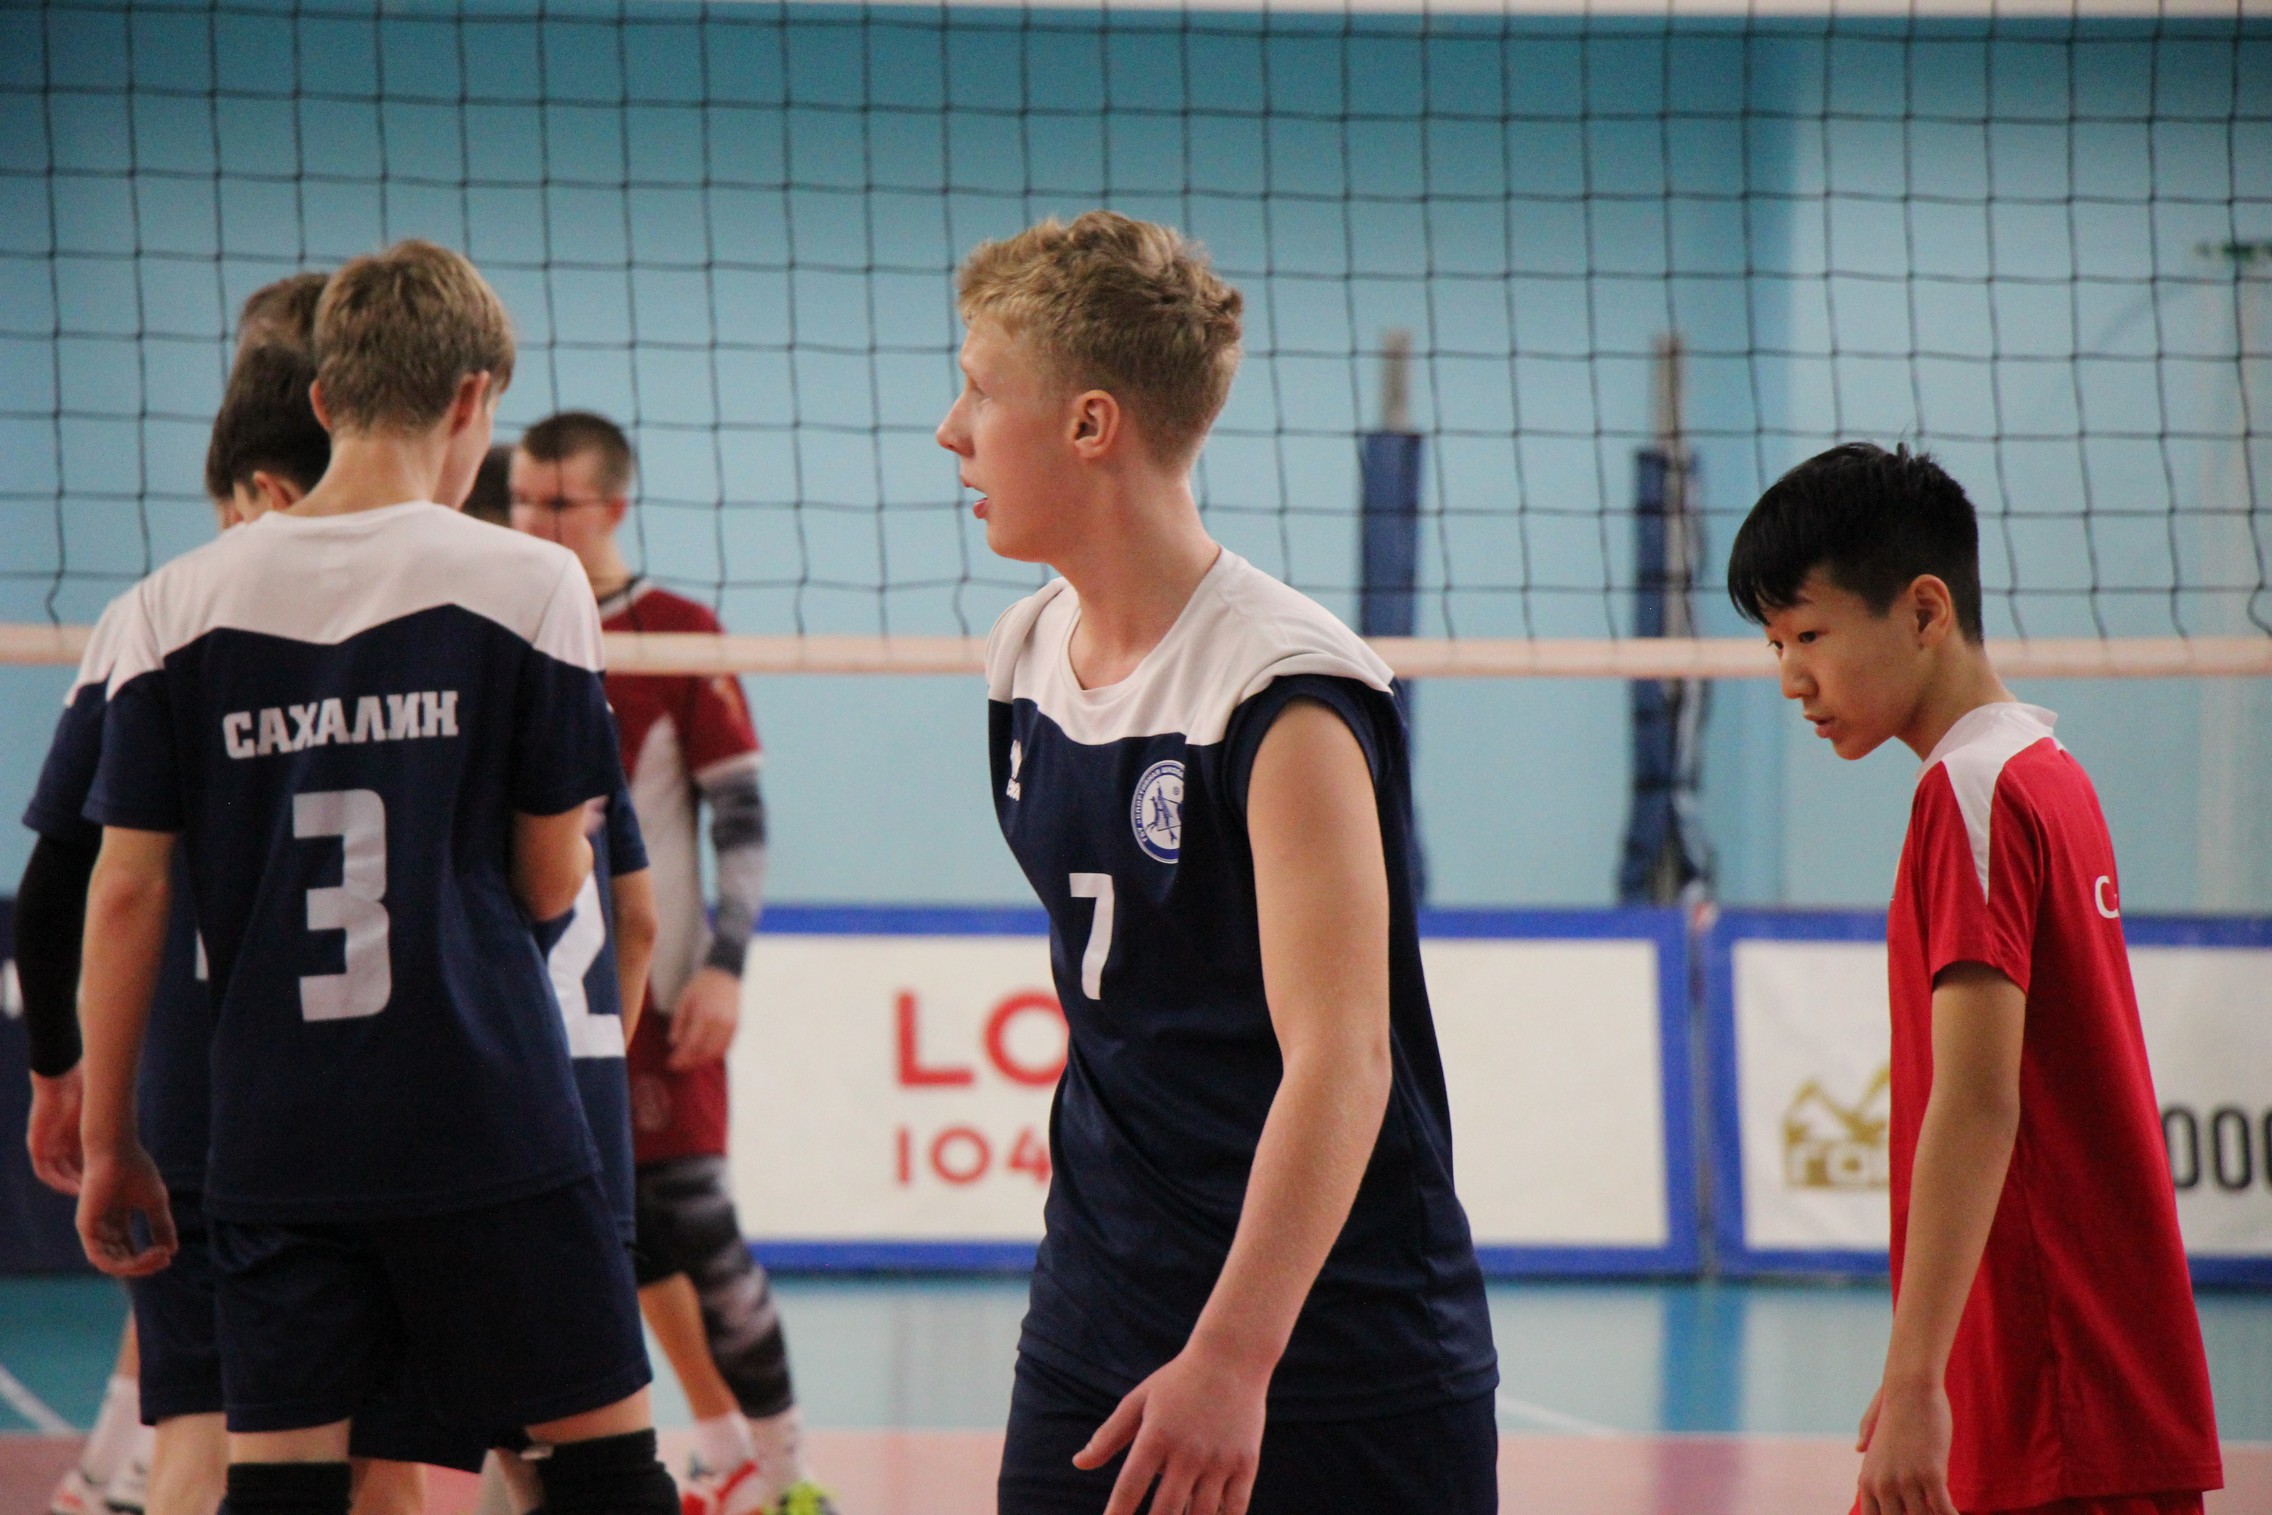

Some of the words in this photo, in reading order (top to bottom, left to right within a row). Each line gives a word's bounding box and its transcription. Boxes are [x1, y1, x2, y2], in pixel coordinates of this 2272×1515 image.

[223, 691, 459, 759] САХАЛИН
[293, 788, 392, 1022] 3
[1068, 872, 1115, 1001] 7
